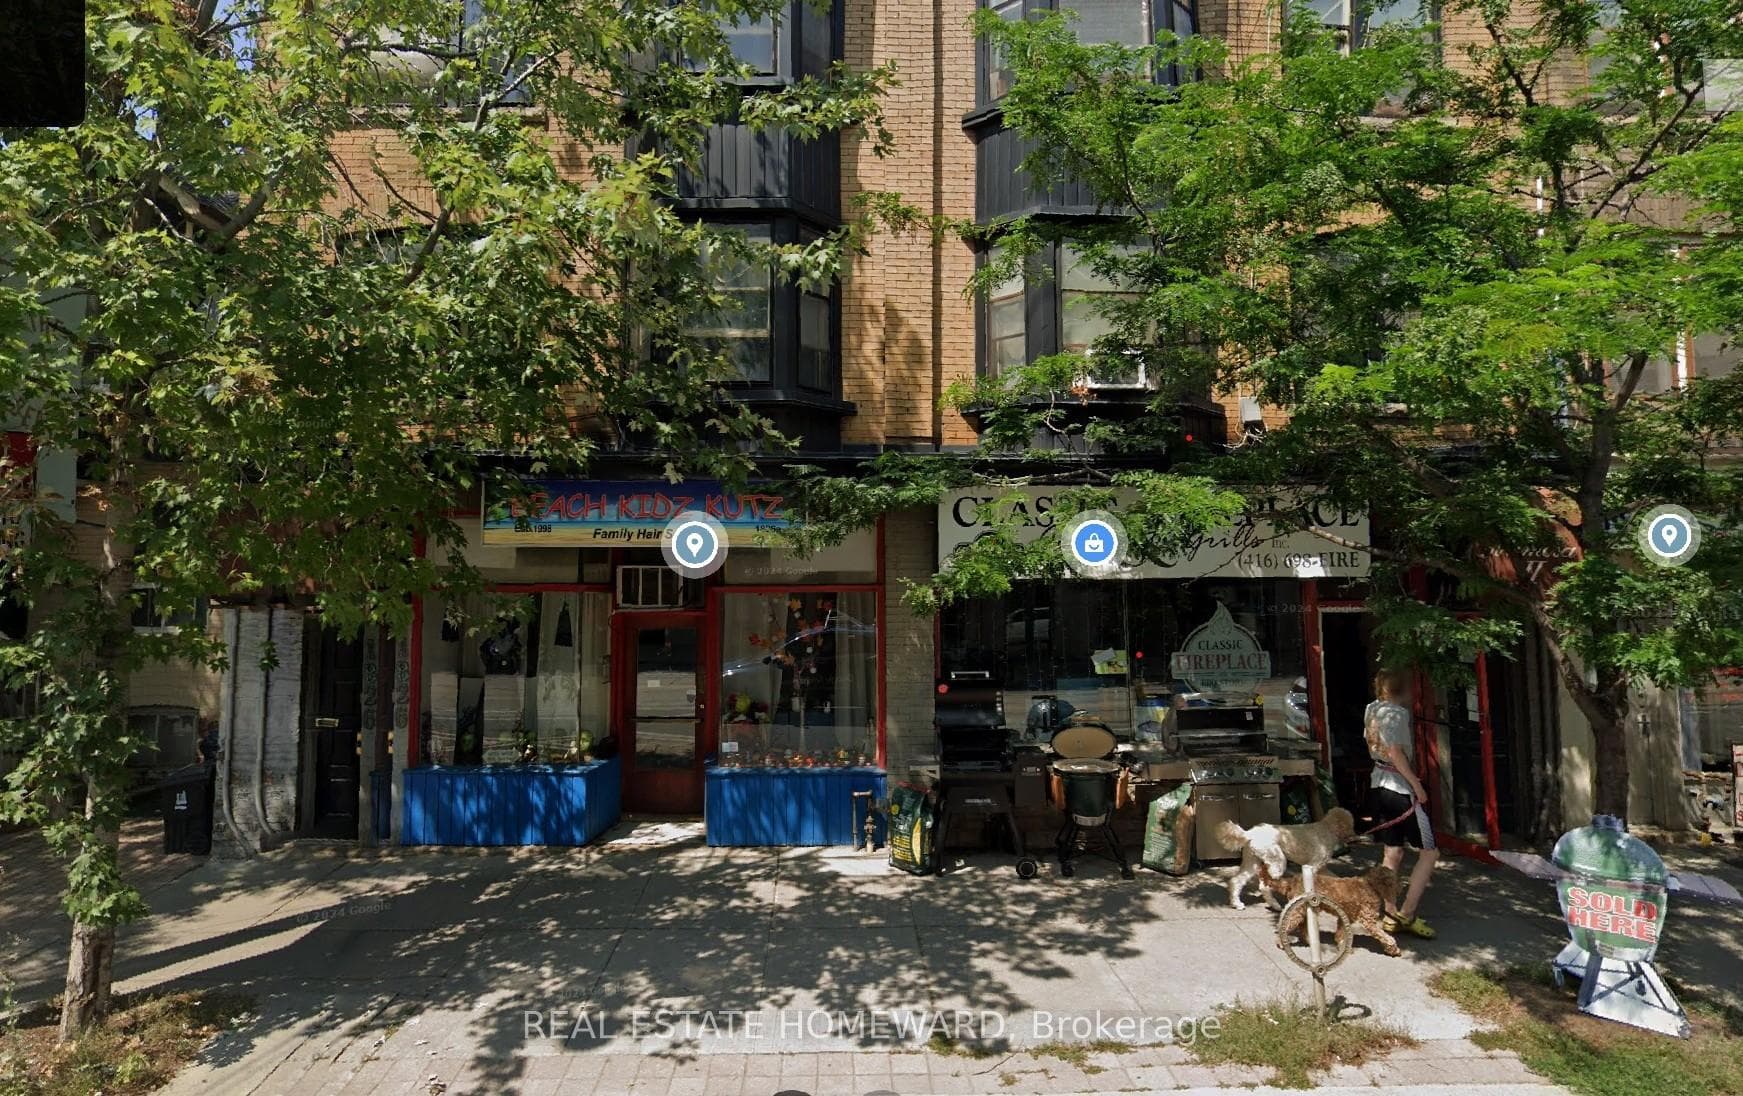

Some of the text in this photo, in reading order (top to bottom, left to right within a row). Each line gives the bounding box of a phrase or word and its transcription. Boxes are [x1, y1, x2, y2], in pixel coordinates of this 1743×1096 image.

[619, 492, 695, 520] KIDZ
[704, 493, 785, 520] KUTZ
[593, 528, 633, 541] Family
[636, 528, 662, 539] Hair
[1237, 552, 1278, 569] (416)
[1198, 639, 1243, 651] CLASSIC
[1567, 885, 1657, 921] SOLD
[1567, 905, 1657, 943] HERE
